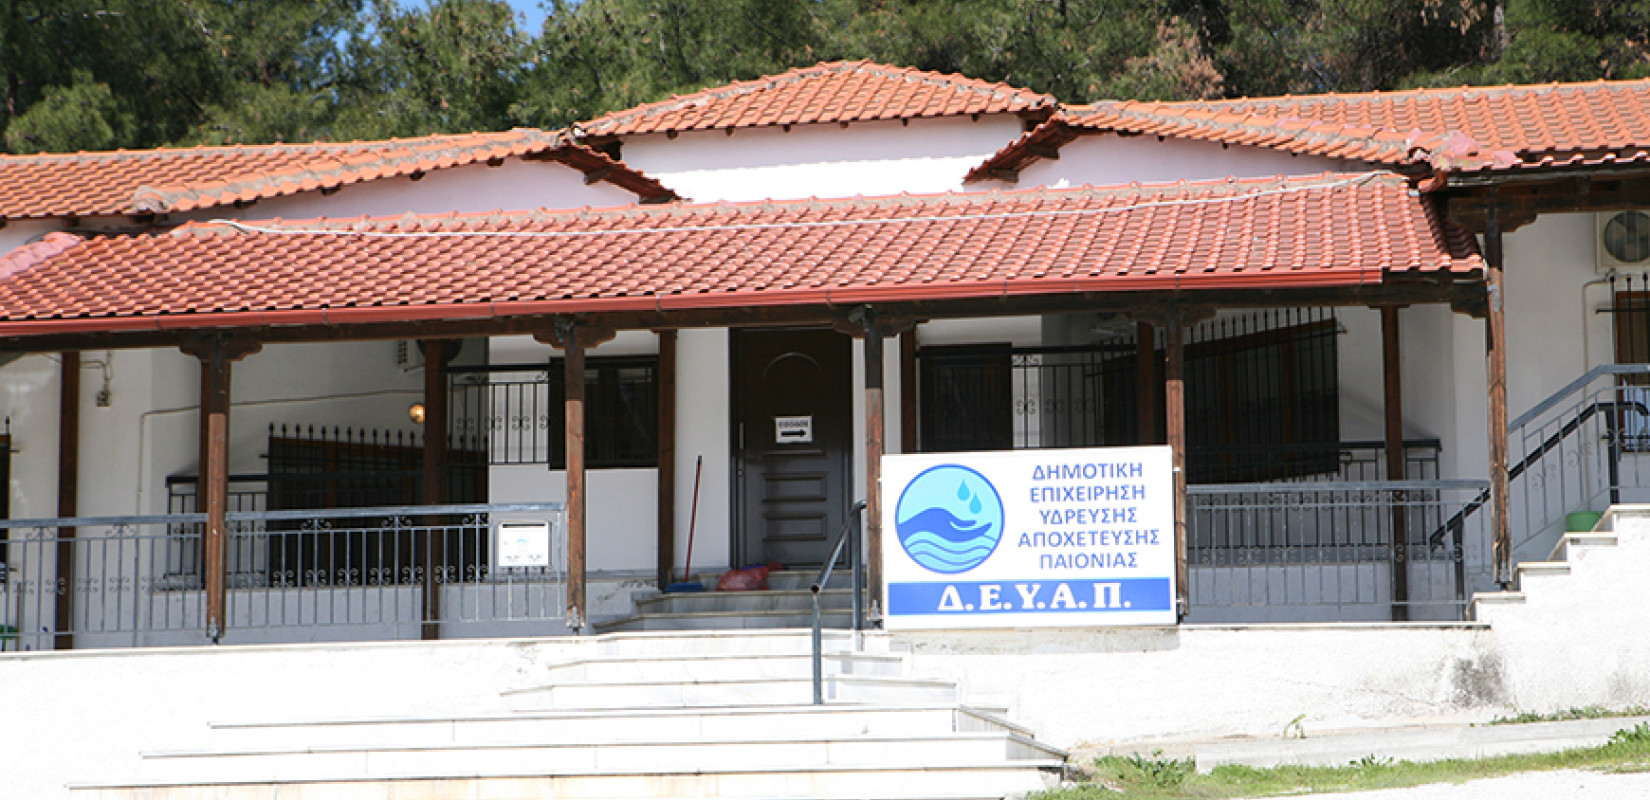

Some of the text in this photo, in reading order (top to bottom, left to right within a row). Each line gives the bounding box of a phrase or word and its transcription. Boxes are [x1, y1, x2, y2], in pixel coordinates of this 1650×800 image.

[1032, 463, 1143, 480] ΔΗΜΟΤΙΚΗ
[1030, 485, 1145, 502] ΕΠΙΧΕΙΡΗΣΗ
[1039, 507, 1138, 524] ΥΔΡΕΥΣΗΣ
[1018, 530, 1160, 547] ΑΠΟΧΕΤΕΥΣΗΣ
[1040, 553, 1138, 569] ΠΑΙΟΝΙΑΣ
